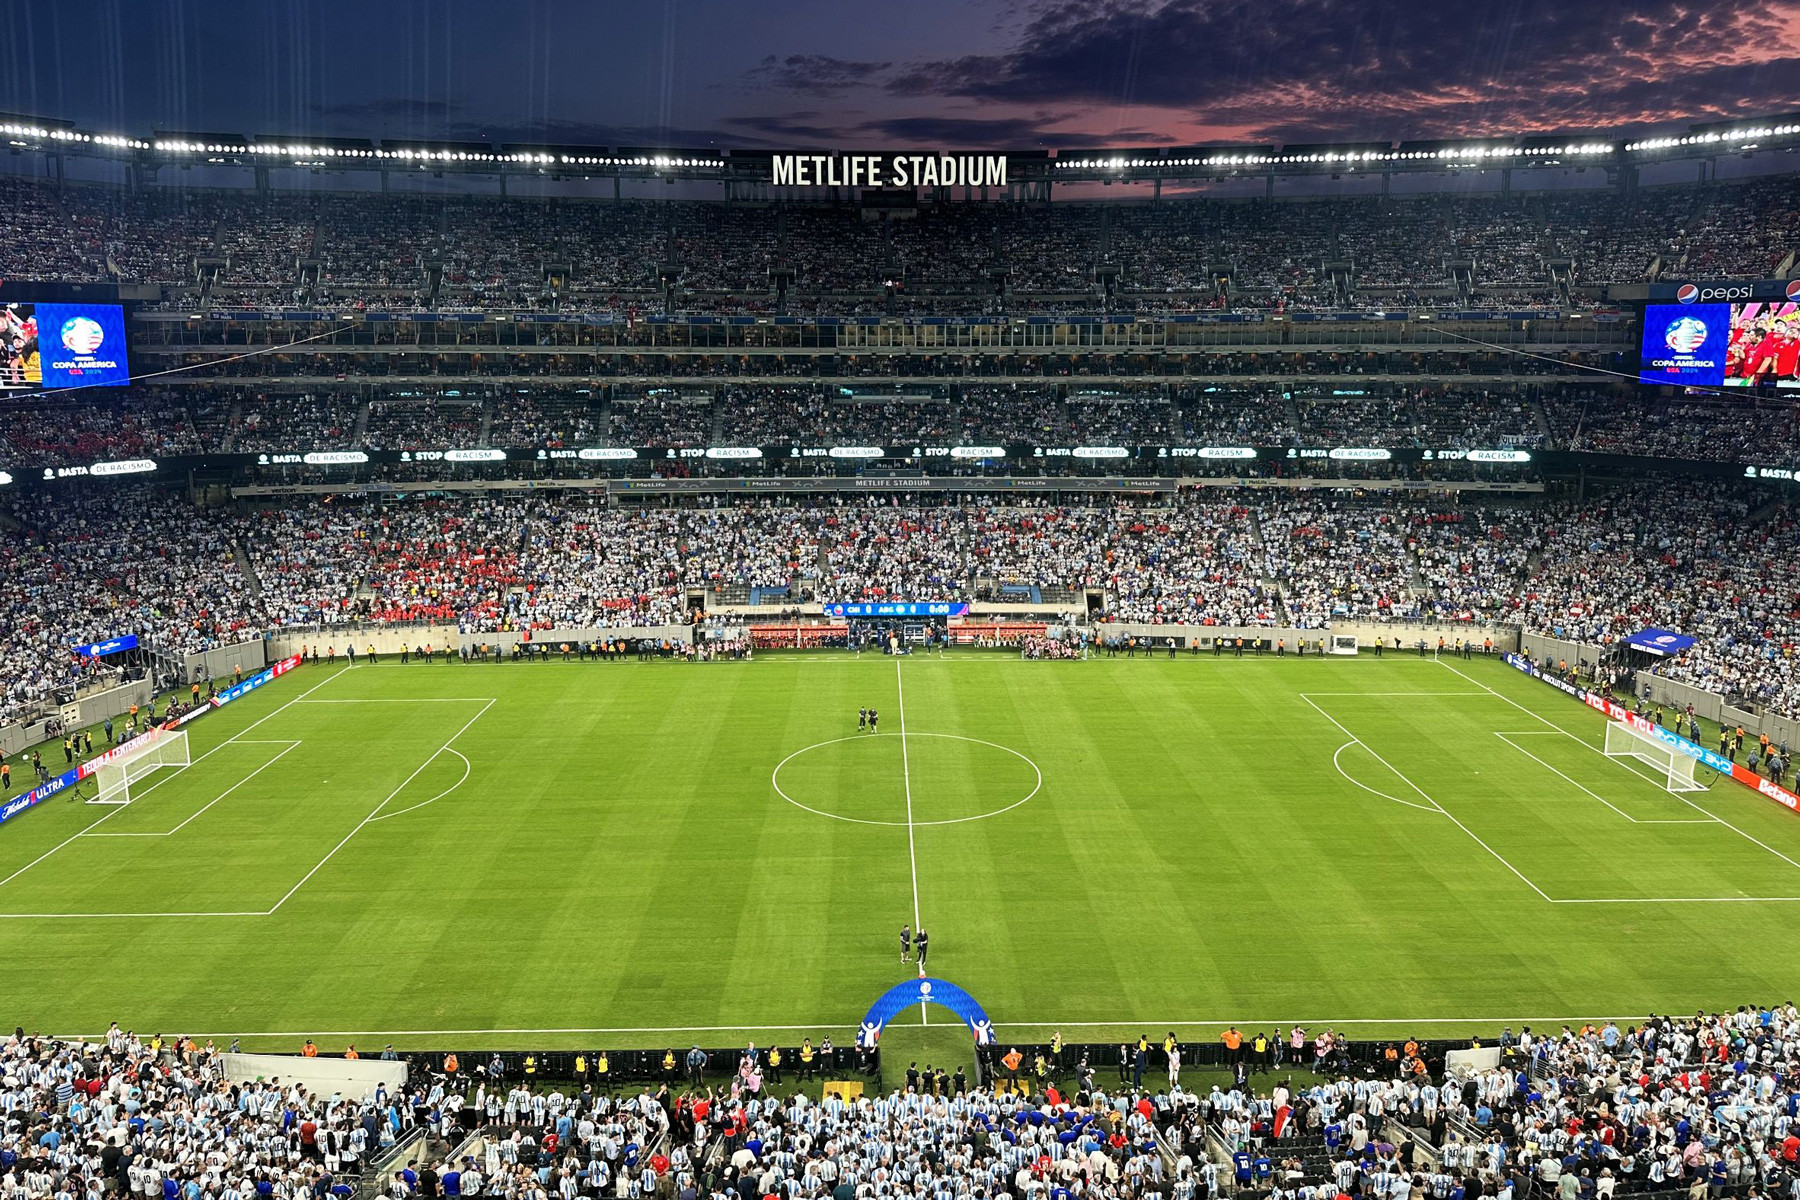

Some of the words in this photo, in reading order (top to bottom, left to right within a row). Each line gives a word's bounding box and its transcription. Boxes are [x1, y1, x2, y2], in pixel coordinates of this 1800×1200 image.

[772, 155, 883, 186] METLIFE
[892, 155, 1007, 186] STADIUM
[1700, 284, 1753, 301] pepsi
[52, 361, 77, 369] COPA
[77, 360, 117, 368] AMERICA
[1675, 360, 1714, 368] AMERICA
[415, 451, 443, 461] STOP
[550, 450, 577, 458] BASTA
[680, 449, 705, 457] STOP
[803, 448, 828, 457] BASTA
[925, 448, 950, 456] STOP
[1046, 448, 1071, 456] BASTA
[1171, 448, 1197, 457] STOP
[1300, 450, 1327, 458] BASTA
[1437, 450, 1465, 460] STOP
[272, 453, 302, 463] BASTA
[323, 453, 363, 461] RACISMO
[58, 466, 89, 477] BASTA
[96, 465, 108, 473] DE
[110, 461, 152, 471] RACISMO
[1760, 468, 1793, 479] BASTA
[1587, 693, 1606, 711] TCL
[1609, 704, 1629, 723] TCL
[1632, 715, 1654, 736] TCL
[82, 753, 111, 775] TEQUILA
[112, 730, 152, 760] CENTENARIO
[36, 778, 64, 799] ULTRA
[1758, 778, 1797, 808] Betano
[1241, 1161, 1249, 1169] 10
[143, 1174, 151, 1184] 10
